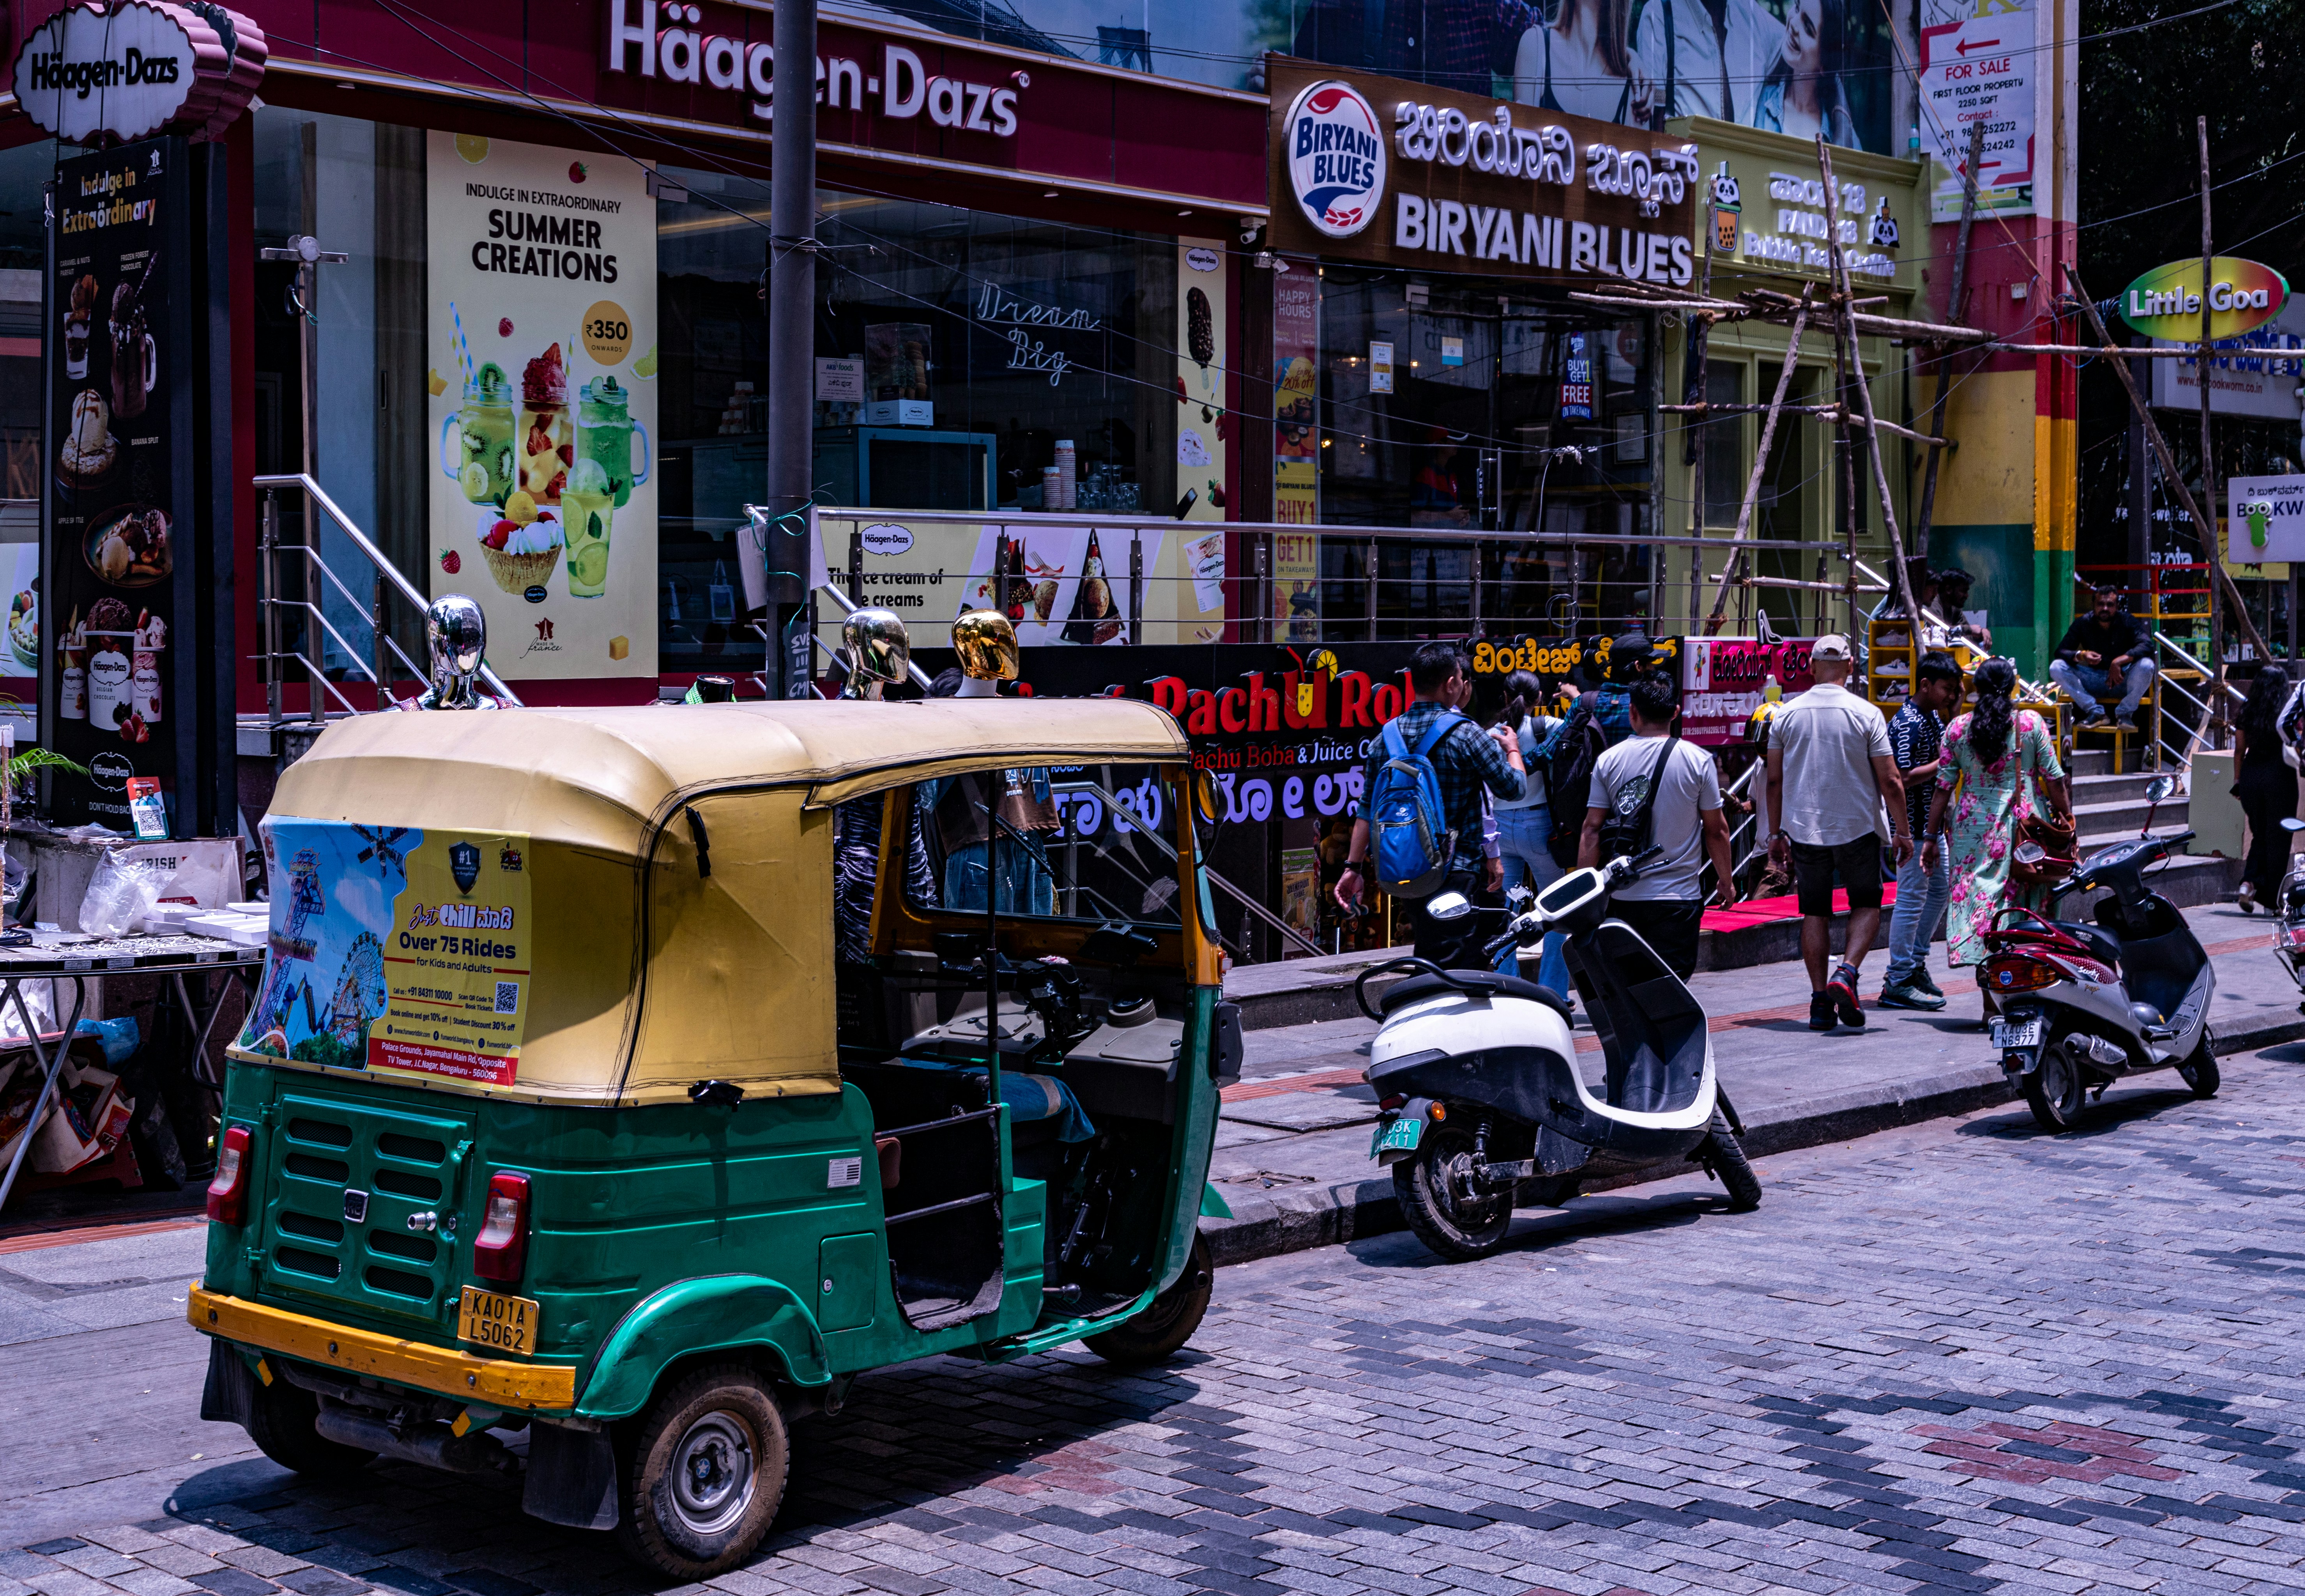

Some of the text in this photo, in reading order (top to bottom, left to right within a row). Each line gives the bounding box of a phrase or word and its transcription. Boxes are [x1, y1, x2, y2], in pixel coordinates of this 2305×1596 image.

[31, 47, 179, 99] Häagen-Dazs
[1946, 58, 2011, 81] FOR SALE
[1933, 78, 2023, 99] FIRST FLOOR PROPERTY
[1958, 95, 1998, 108] 2250 SQFT
[1957, 111, 1993, 122] Contact
[1296, 117, 1377, 159] BIRYANI
[1395, 101, 1575, 186] ಬಿರಿಯಾನಿ
[1940, 129, 1954, 140] +91
[81, 166, 135, 196] Indulge in
[1313, 155, 1375, 189] BLUES
[466, 183, 621, 214] INDULGE IN EXTRAORDINARY
[62, 198, 156, 234] Extraördinary
[1778, 209, 1828, 239] PAND
[488, 209, 601, 249] SUMMER
[1395, 193, 1694, 287] BIRYANI BLUES
[1744, 232, 1801, 263] Bubble
[60, 258, 76, 267] CARAMEL
[121, 262, 142, 271] CHOCOLATE
[472, 241, 617, 284] CREATIONS
[977, 279, 1100, 331] Dream
[1279, 289, 1311, 304] HAPPY
[2130, 282, 2270, 317] Little Goa
[1279, 303, 1311, 318] HOURS
[586, 319, 628, 340] ₹350
[838, 363, 854, 371] foods
[1007, 327, 1072, 386] Big
[1568, 359, 1585, 371] BUY
[1570, 371, 1587, 382] GET
[1563, 385, 1589, 403] FREE
[1563, 405, 1590, 418] ON TAKEAWAY
[1277, 499, 1315, 525] BUY 1
[865, 534, 909, 545] Häagen-Dazs
[1277, 535, 1313, 563] GET 1
[882, 568, 943, 585] cream of
[873, 595, 924, 607] creams
[94, 661, 127, 674] Häagen-Dazs
[1247, 745, 1295, 765] Boba
[1298, 747, 1307, 763] &
[1313, 741, 1353, 764] Juice
[94, 764, 129, 778] Häagen-Dazs
[89, 802, 119, 813] DON'T HOLD
[459, 850, 471, 865] #1
[409, 903, 514, 930] Just Chill ಮಾಡಿ
[400, 932, 516, 959] Over 75 Rides
[416, 957, 492, 973] for Kids and Adults
[408, 987, 417, 996] +91
[418, 987, 433, 998] 84311
[435, 990, 452, 1001] 10000
[430, 1012, 441, 1022] 10%
[453, 1017, 470, 1026] Student
[471, 1019, 491, 1029] Discount
[492, 1021, 500, 1030] 30
[2002, 1023, 2035, 1035] KA03E
[2001, 1034, 2034, 1046] N6977
[382, 1041, 506, 1068] Palace Grounds, Jayamahal Main Rd, Opposite
[387, 1055, 395, 1063] TV
[396, 1056, 413, 1067] Tower,
[414, 1059, 439, 1071] J.C.Nagar,
[440, 1063, 467, 1075] Bengaluru
[472, 1292, 524, 1325] KA01A
[470, 1316, 524, 1350] L5062
